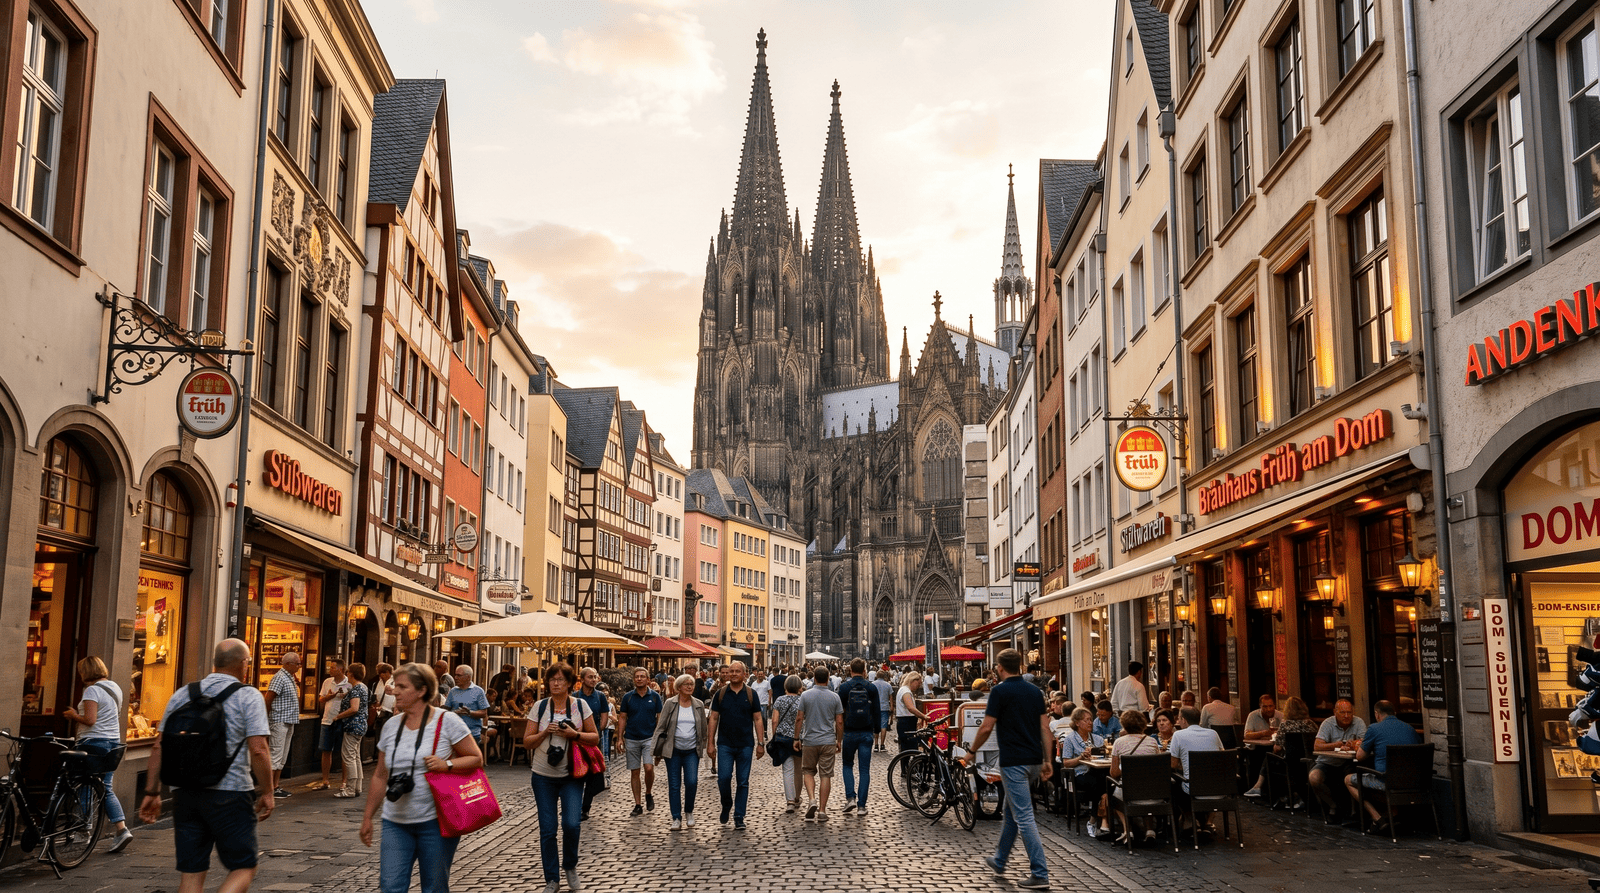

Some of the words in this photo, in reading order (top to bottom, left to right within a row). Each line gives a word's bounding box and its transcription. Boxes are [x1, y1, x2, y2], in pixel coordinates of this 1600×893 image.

[264, 449, 342, 516] Süßwaren
[1199, 468, 1257, 515] Bräuhaus
[1260, 443, 1297, 489] Früh
[1301, 435, 1330, 471] am
[1334, 408, 1385, 457] Dom
[1521, 498, 1600, 549] DOM
[1491, 604, 1504, 637] DOM
